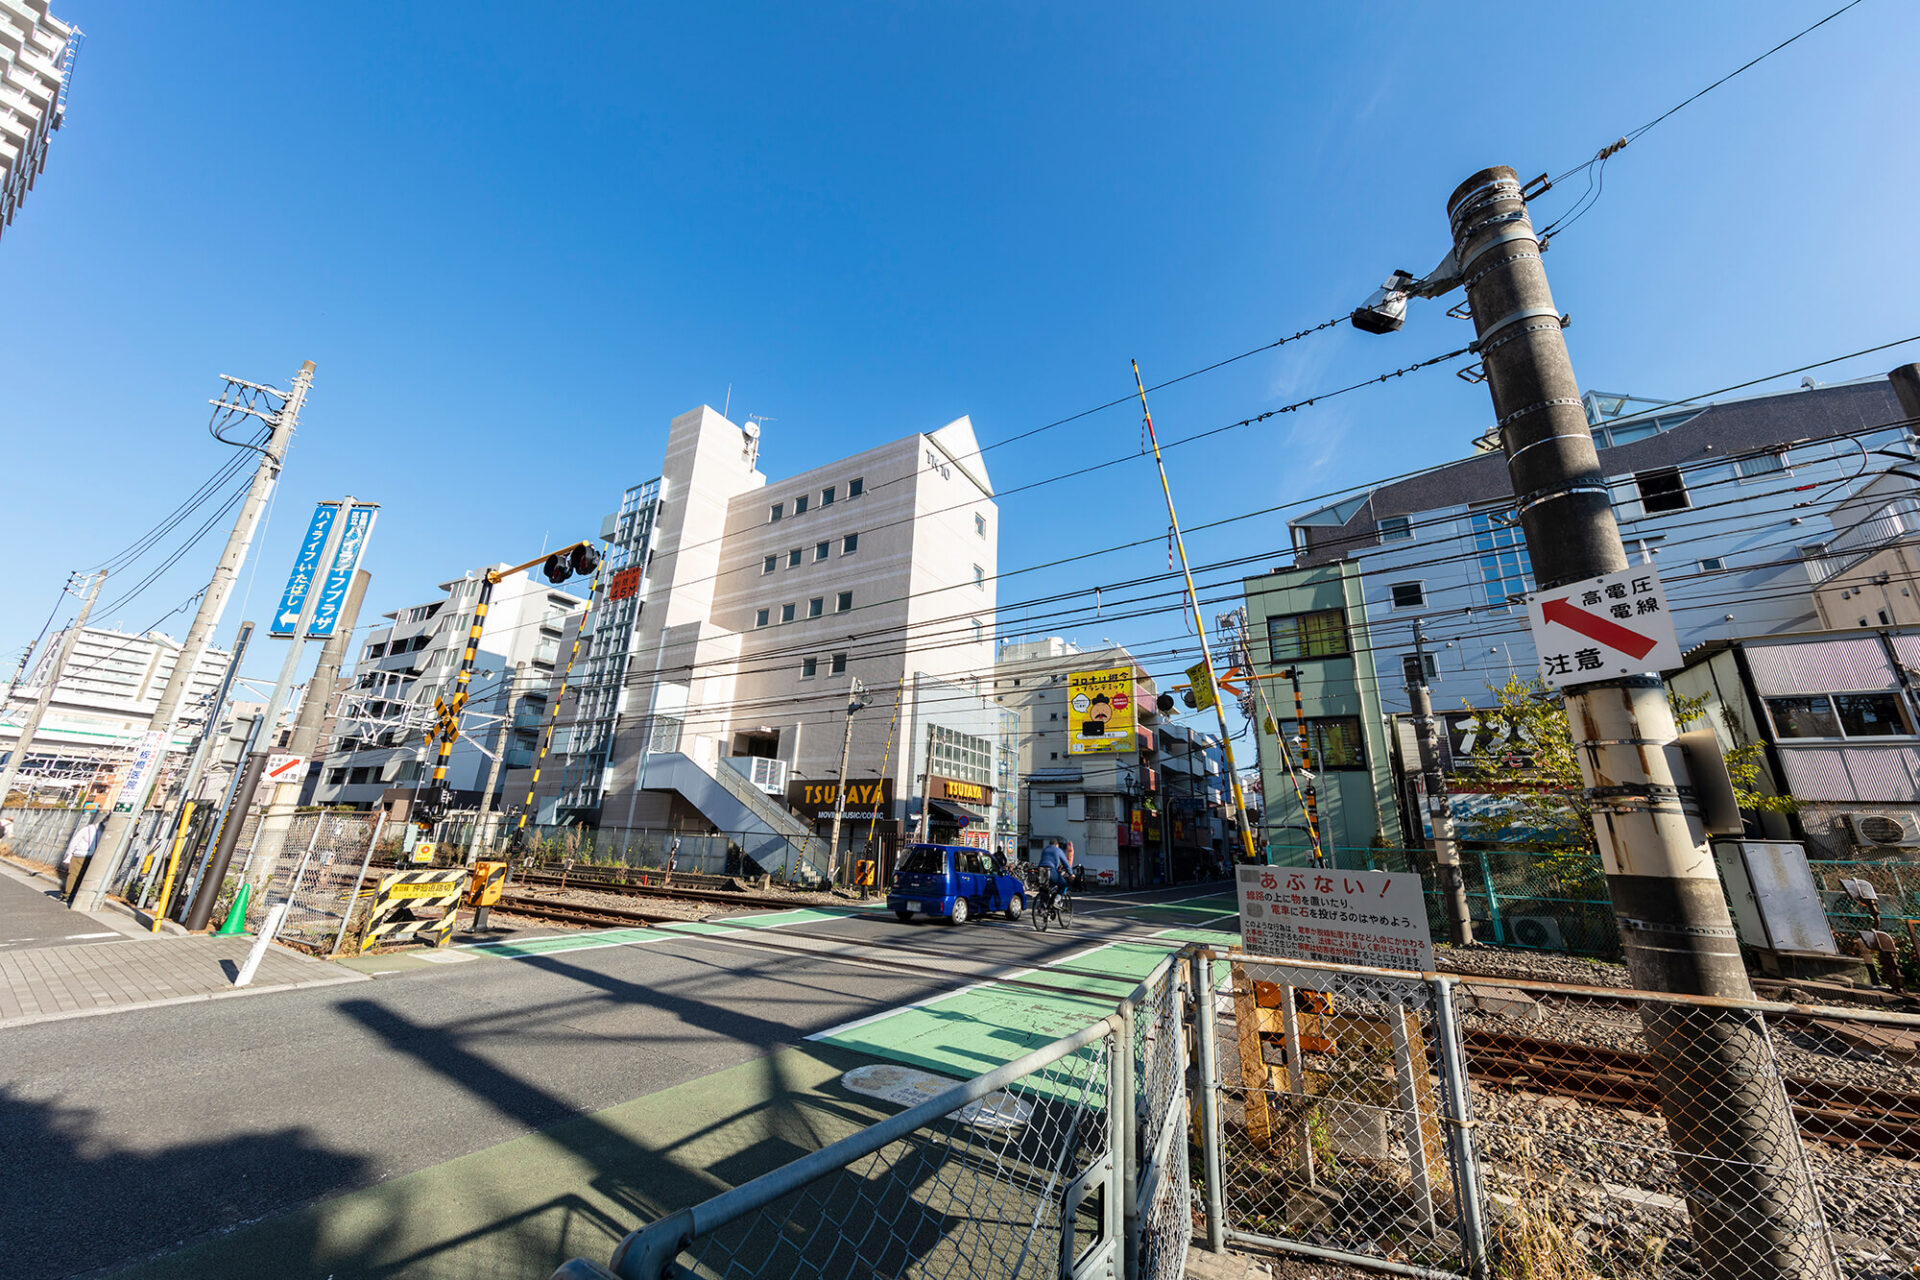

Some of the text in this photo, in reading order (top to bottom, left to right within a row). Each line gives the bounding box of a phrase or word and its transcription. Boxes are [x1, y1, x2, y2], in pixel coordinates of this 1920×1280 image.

[287, 511, 330, 606] ハイライフいたばし
[316, 526, 363, 630] ハイライフプラザ
[1581, 575, 1653, 606] 高電圧
[1610, 597, 1660, 619] 電線
[1544, 648, 1604, 676] 注意
[804, 784, 885, 804] TSUAYA
[946, 781, 983, 799] TSUTAYA
[1260, 871, 1391, 899] あぶない！
[1245, 890, 1354, 910] 線路の上に物を置いたり、
[1271, 904, 1417, 929] 電車に石を投げるのはやめよう。
